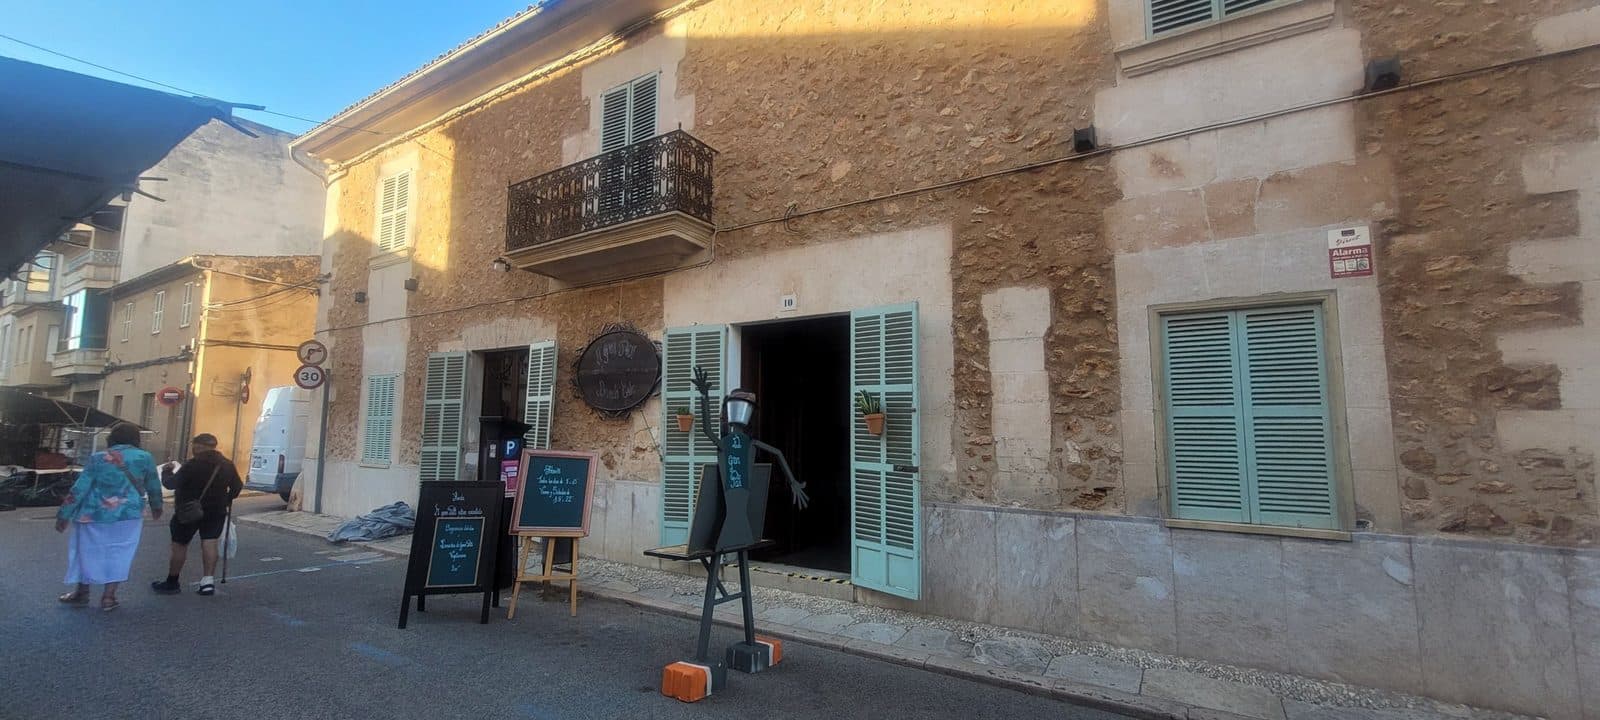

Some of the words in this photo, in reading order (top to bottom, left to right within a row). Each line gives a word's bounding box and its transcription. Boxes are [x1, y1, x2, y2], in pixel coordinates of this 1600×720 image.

[1332, 248, 1368, 257] Alarma
[784, 298, 793, 307] 10
[301, 372, 319, 382] 30
[506, 440, 516, 455] P
